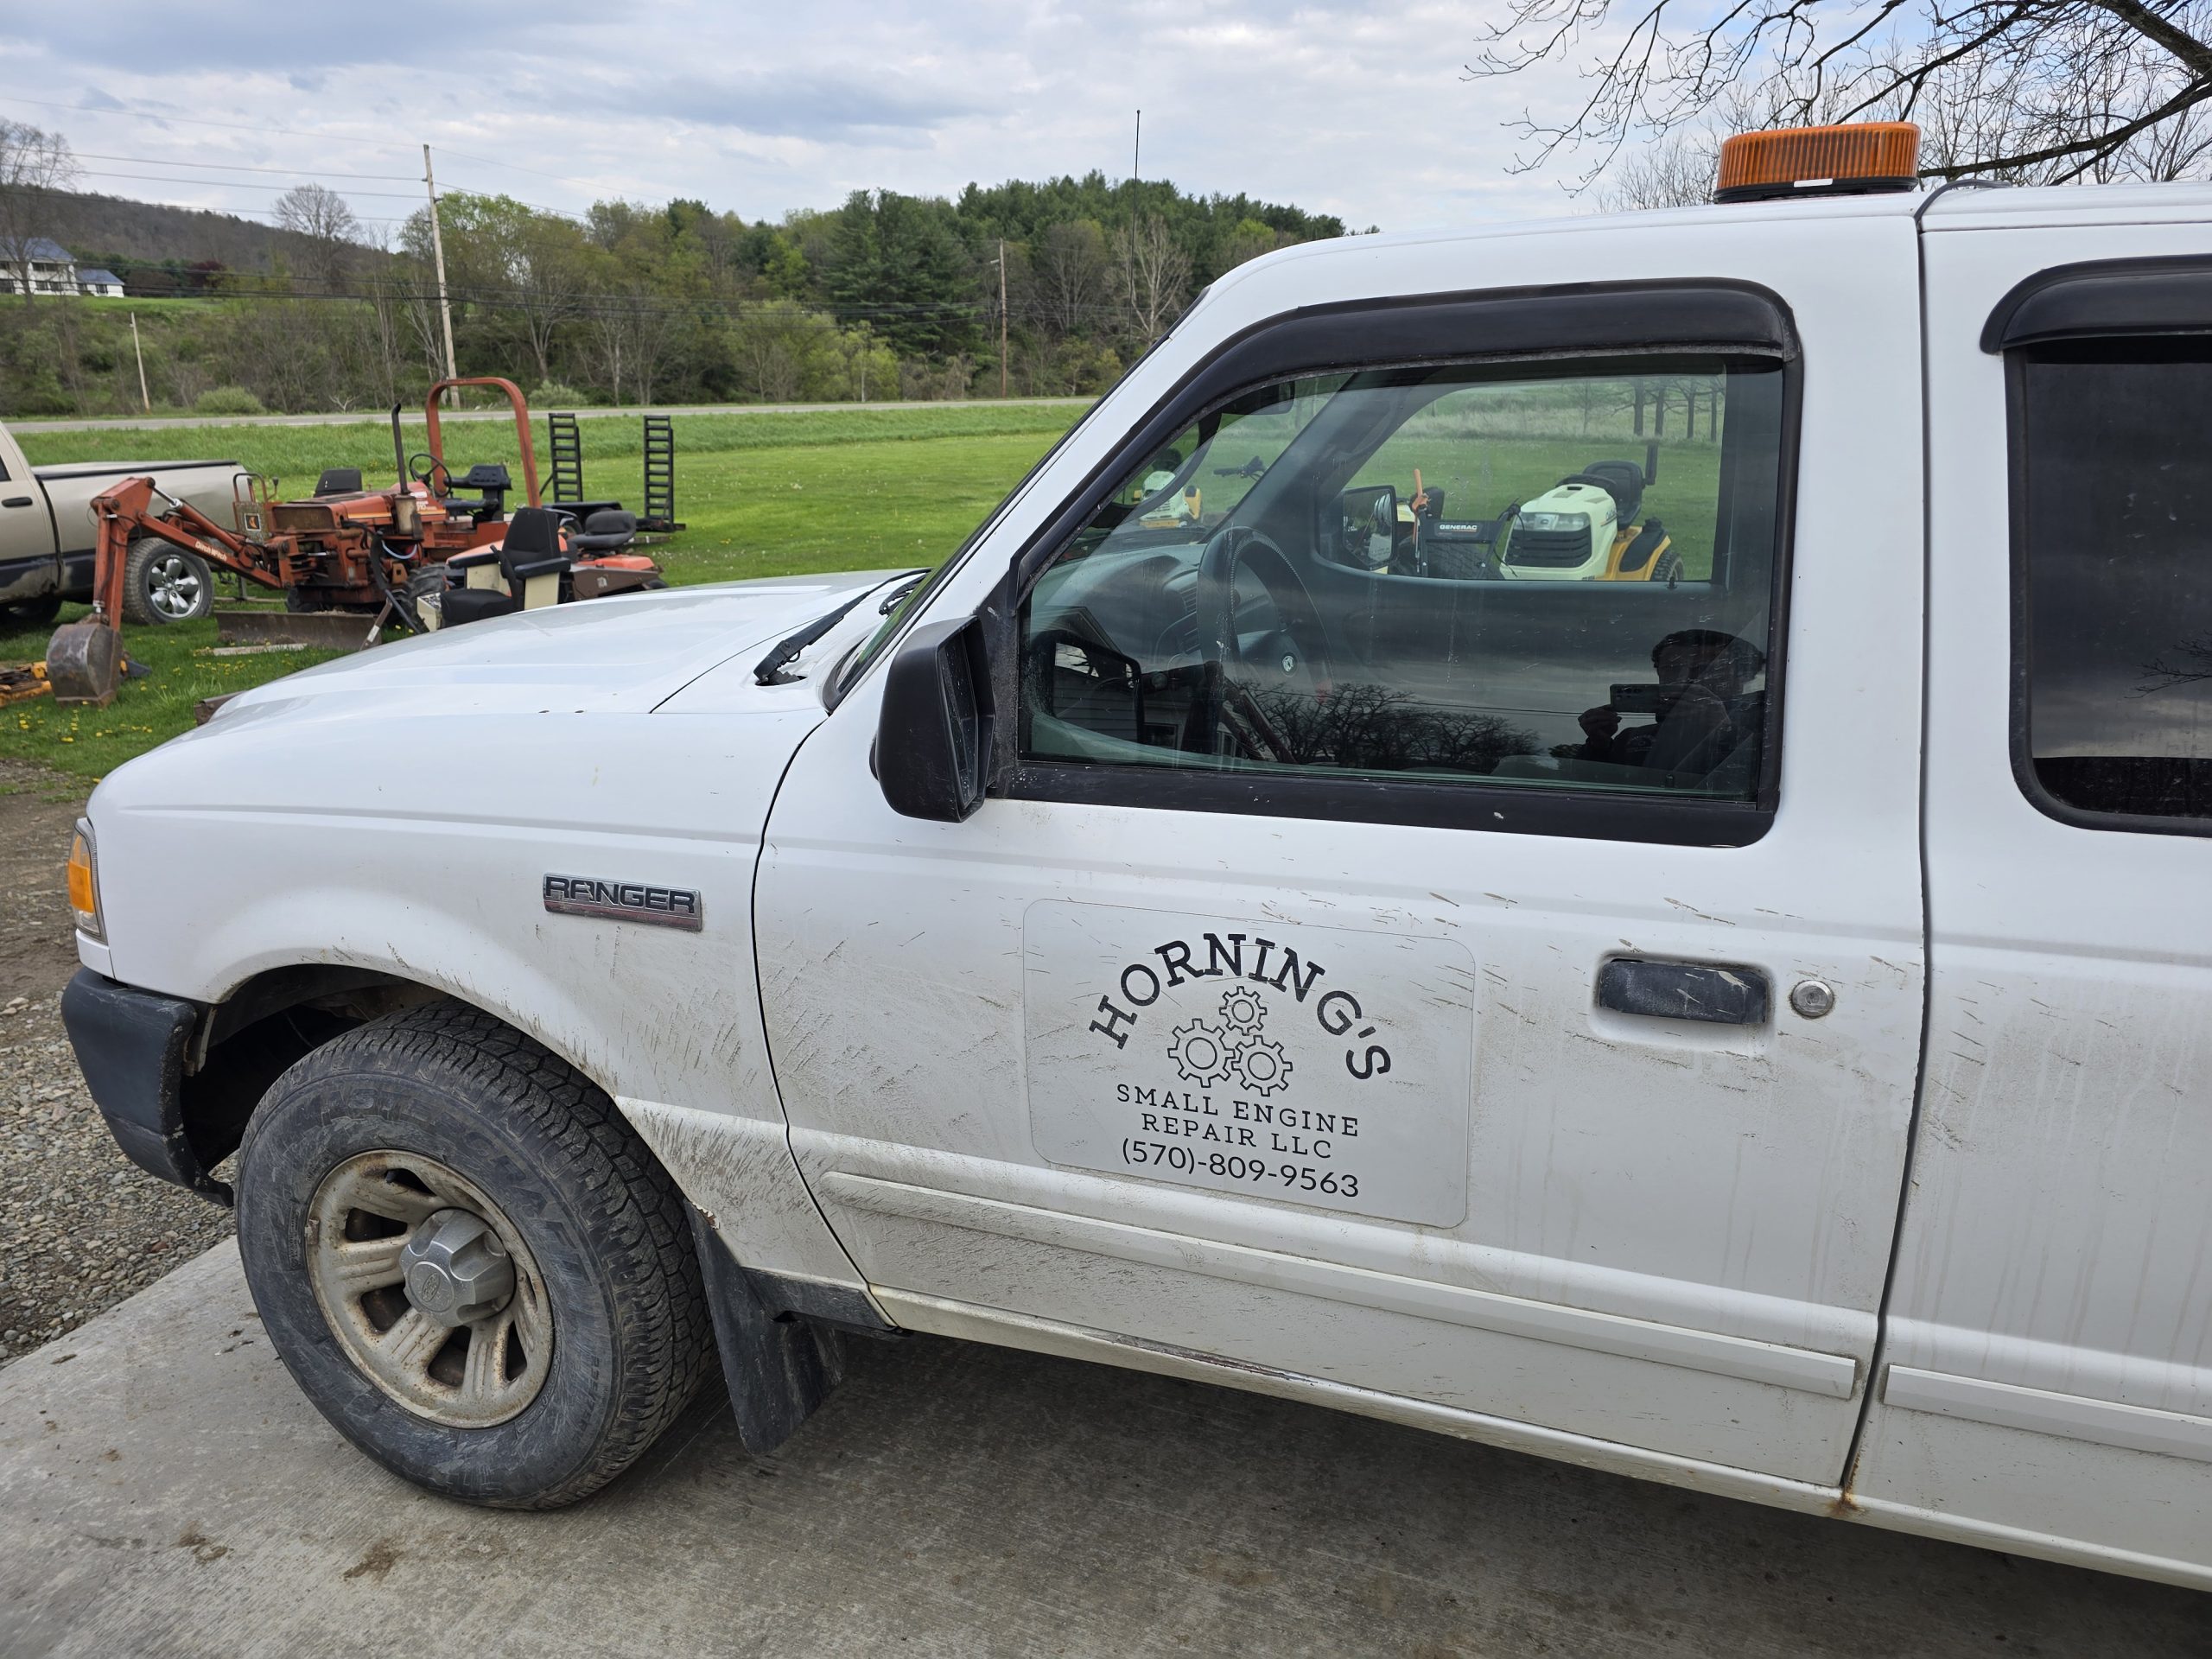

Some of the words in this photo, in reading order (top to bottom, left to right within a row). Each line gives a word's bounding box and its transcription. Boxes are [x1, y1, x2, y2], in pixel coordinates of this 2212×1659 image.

[546, 876, 695, 913] RANGER
[1089, 933, 1391, 1080] HORNING'S
[1117, 1084, 1218, 1115] SMALL
[1233, 1101, 1358, 1136] ENGINE
[1142, 1113, 1255, 1147] REPAIR
[1272, 1134, 1332, 1159] LLC
[1122, 1139, 1358, 1197] (570)-809-9563
